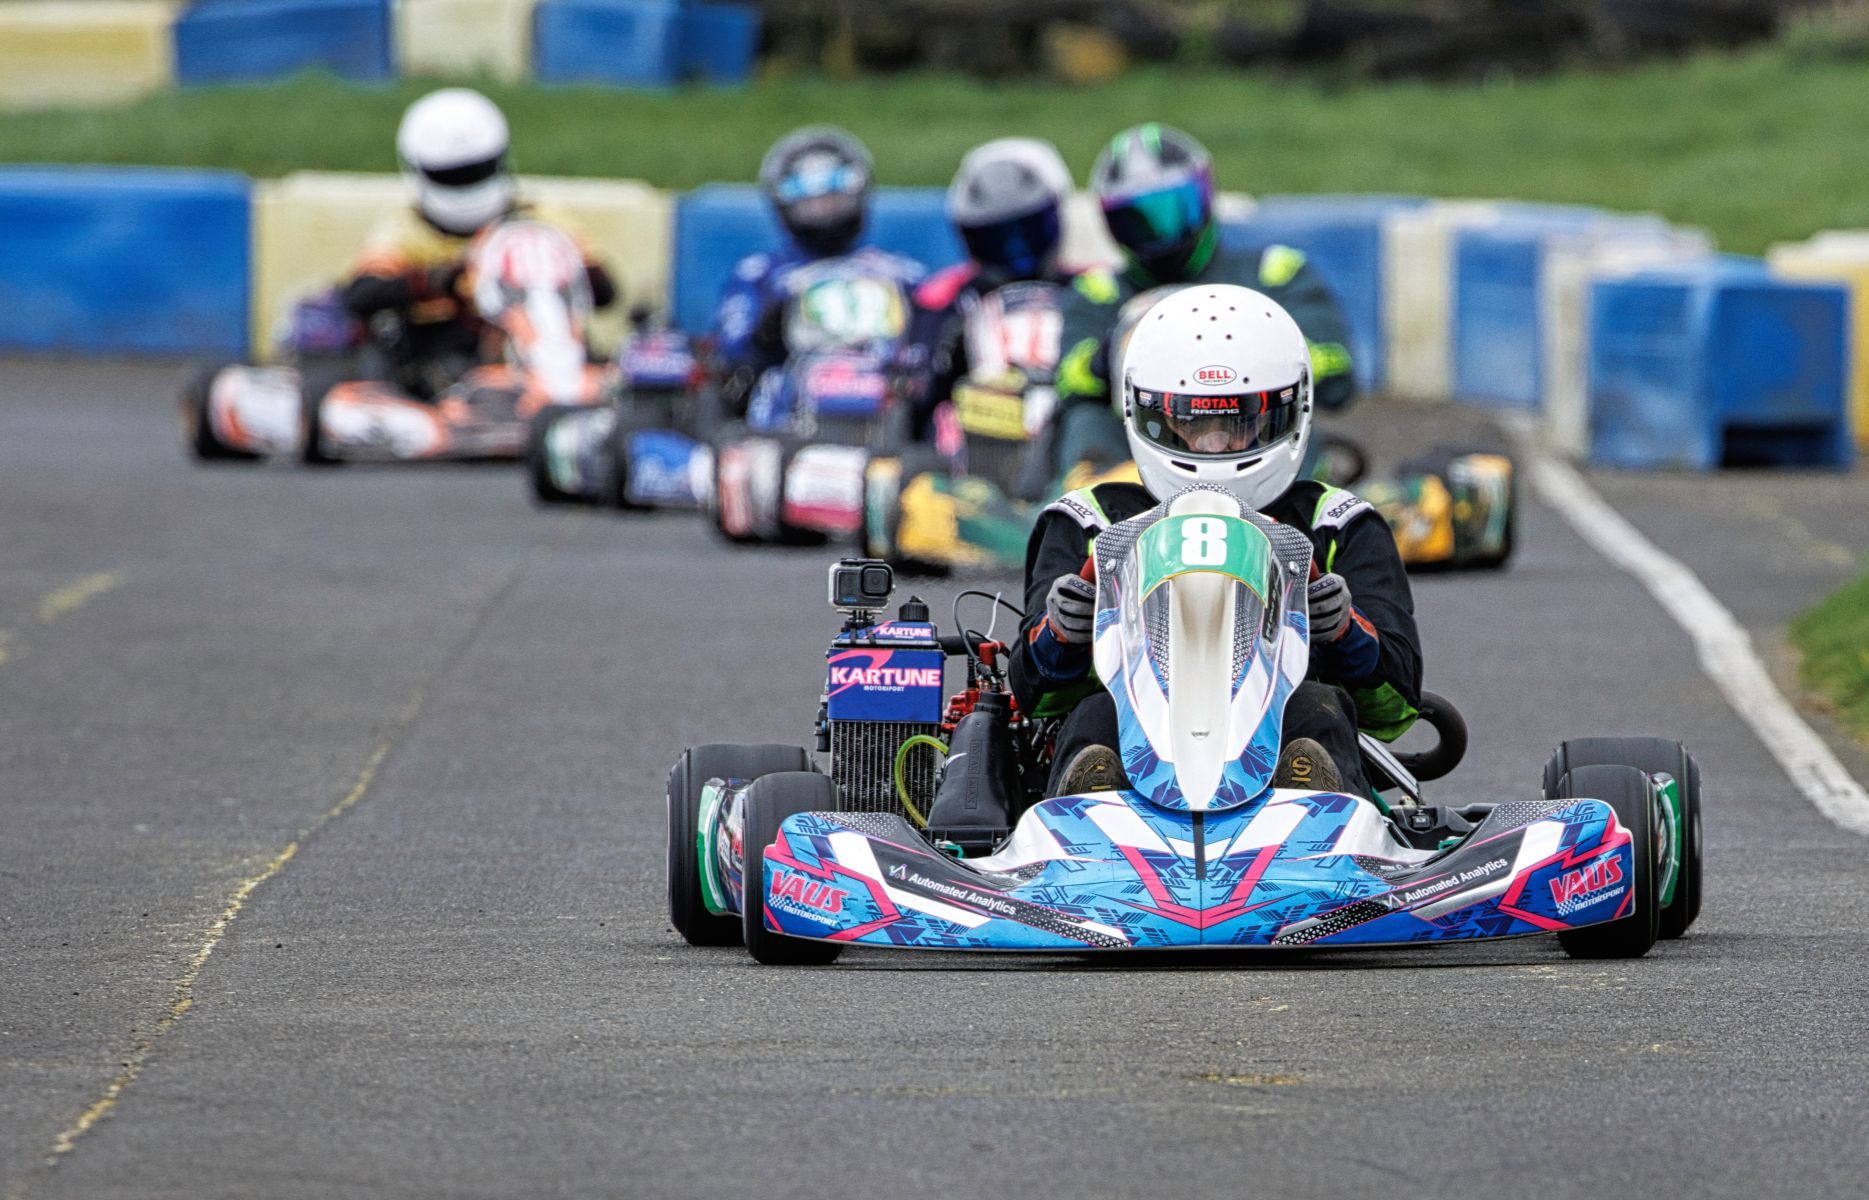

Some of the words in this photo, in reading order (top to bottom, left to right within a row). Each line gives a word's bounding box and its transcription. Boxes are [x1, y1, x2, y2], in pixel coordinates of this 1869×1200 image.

[1199, 369, 1232, 380] BELL
[1191, 397, 1240, 409] ROTAX
[1181, 516, 1228, 566] 8
[880, 626, 932, 638] KARTUNE
[831, 666, 942, 687] KARTUNE
[770, 868, 849, 914] VAUS
[1404, 875, 1461, 903] Automated
[1459, 858, 1508, 882] Analytics
[1548, 853, 1624, 905] VAUS
[908, 873, 968, 899] Automated
[967, 892, 1017, 915] Analytics
[1574, 885, 1625, 911] MOTORSPORT
[782, 904, 839, 927] MOTORSPORT
